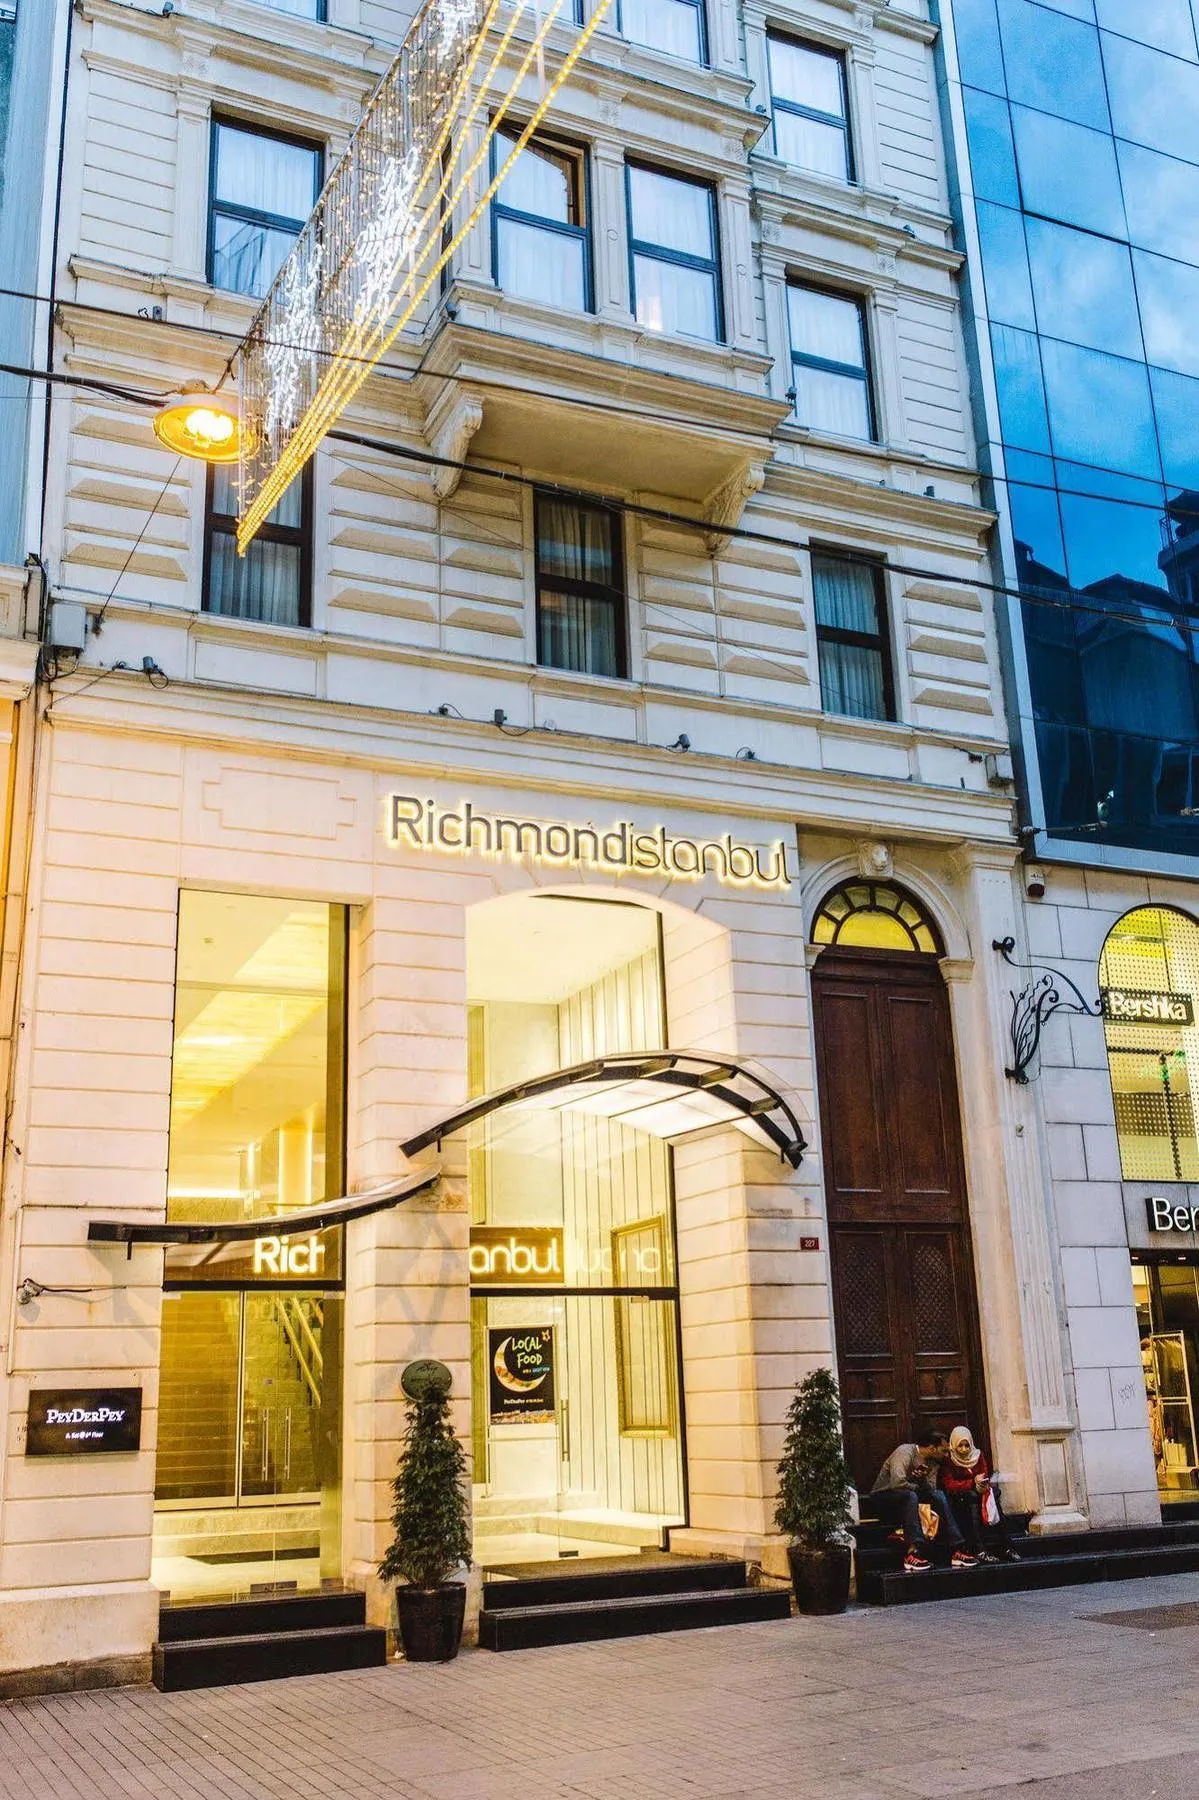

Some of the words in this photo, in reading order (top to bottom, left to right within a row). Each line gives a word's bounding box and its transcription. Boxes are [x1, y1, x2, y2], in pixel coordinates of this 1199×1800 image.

[1108, 991, 1188, 1021] Bershka
[511, 1336, 542, 1352] LOCAL
[517, 1352, 542, 1368] FOOD
